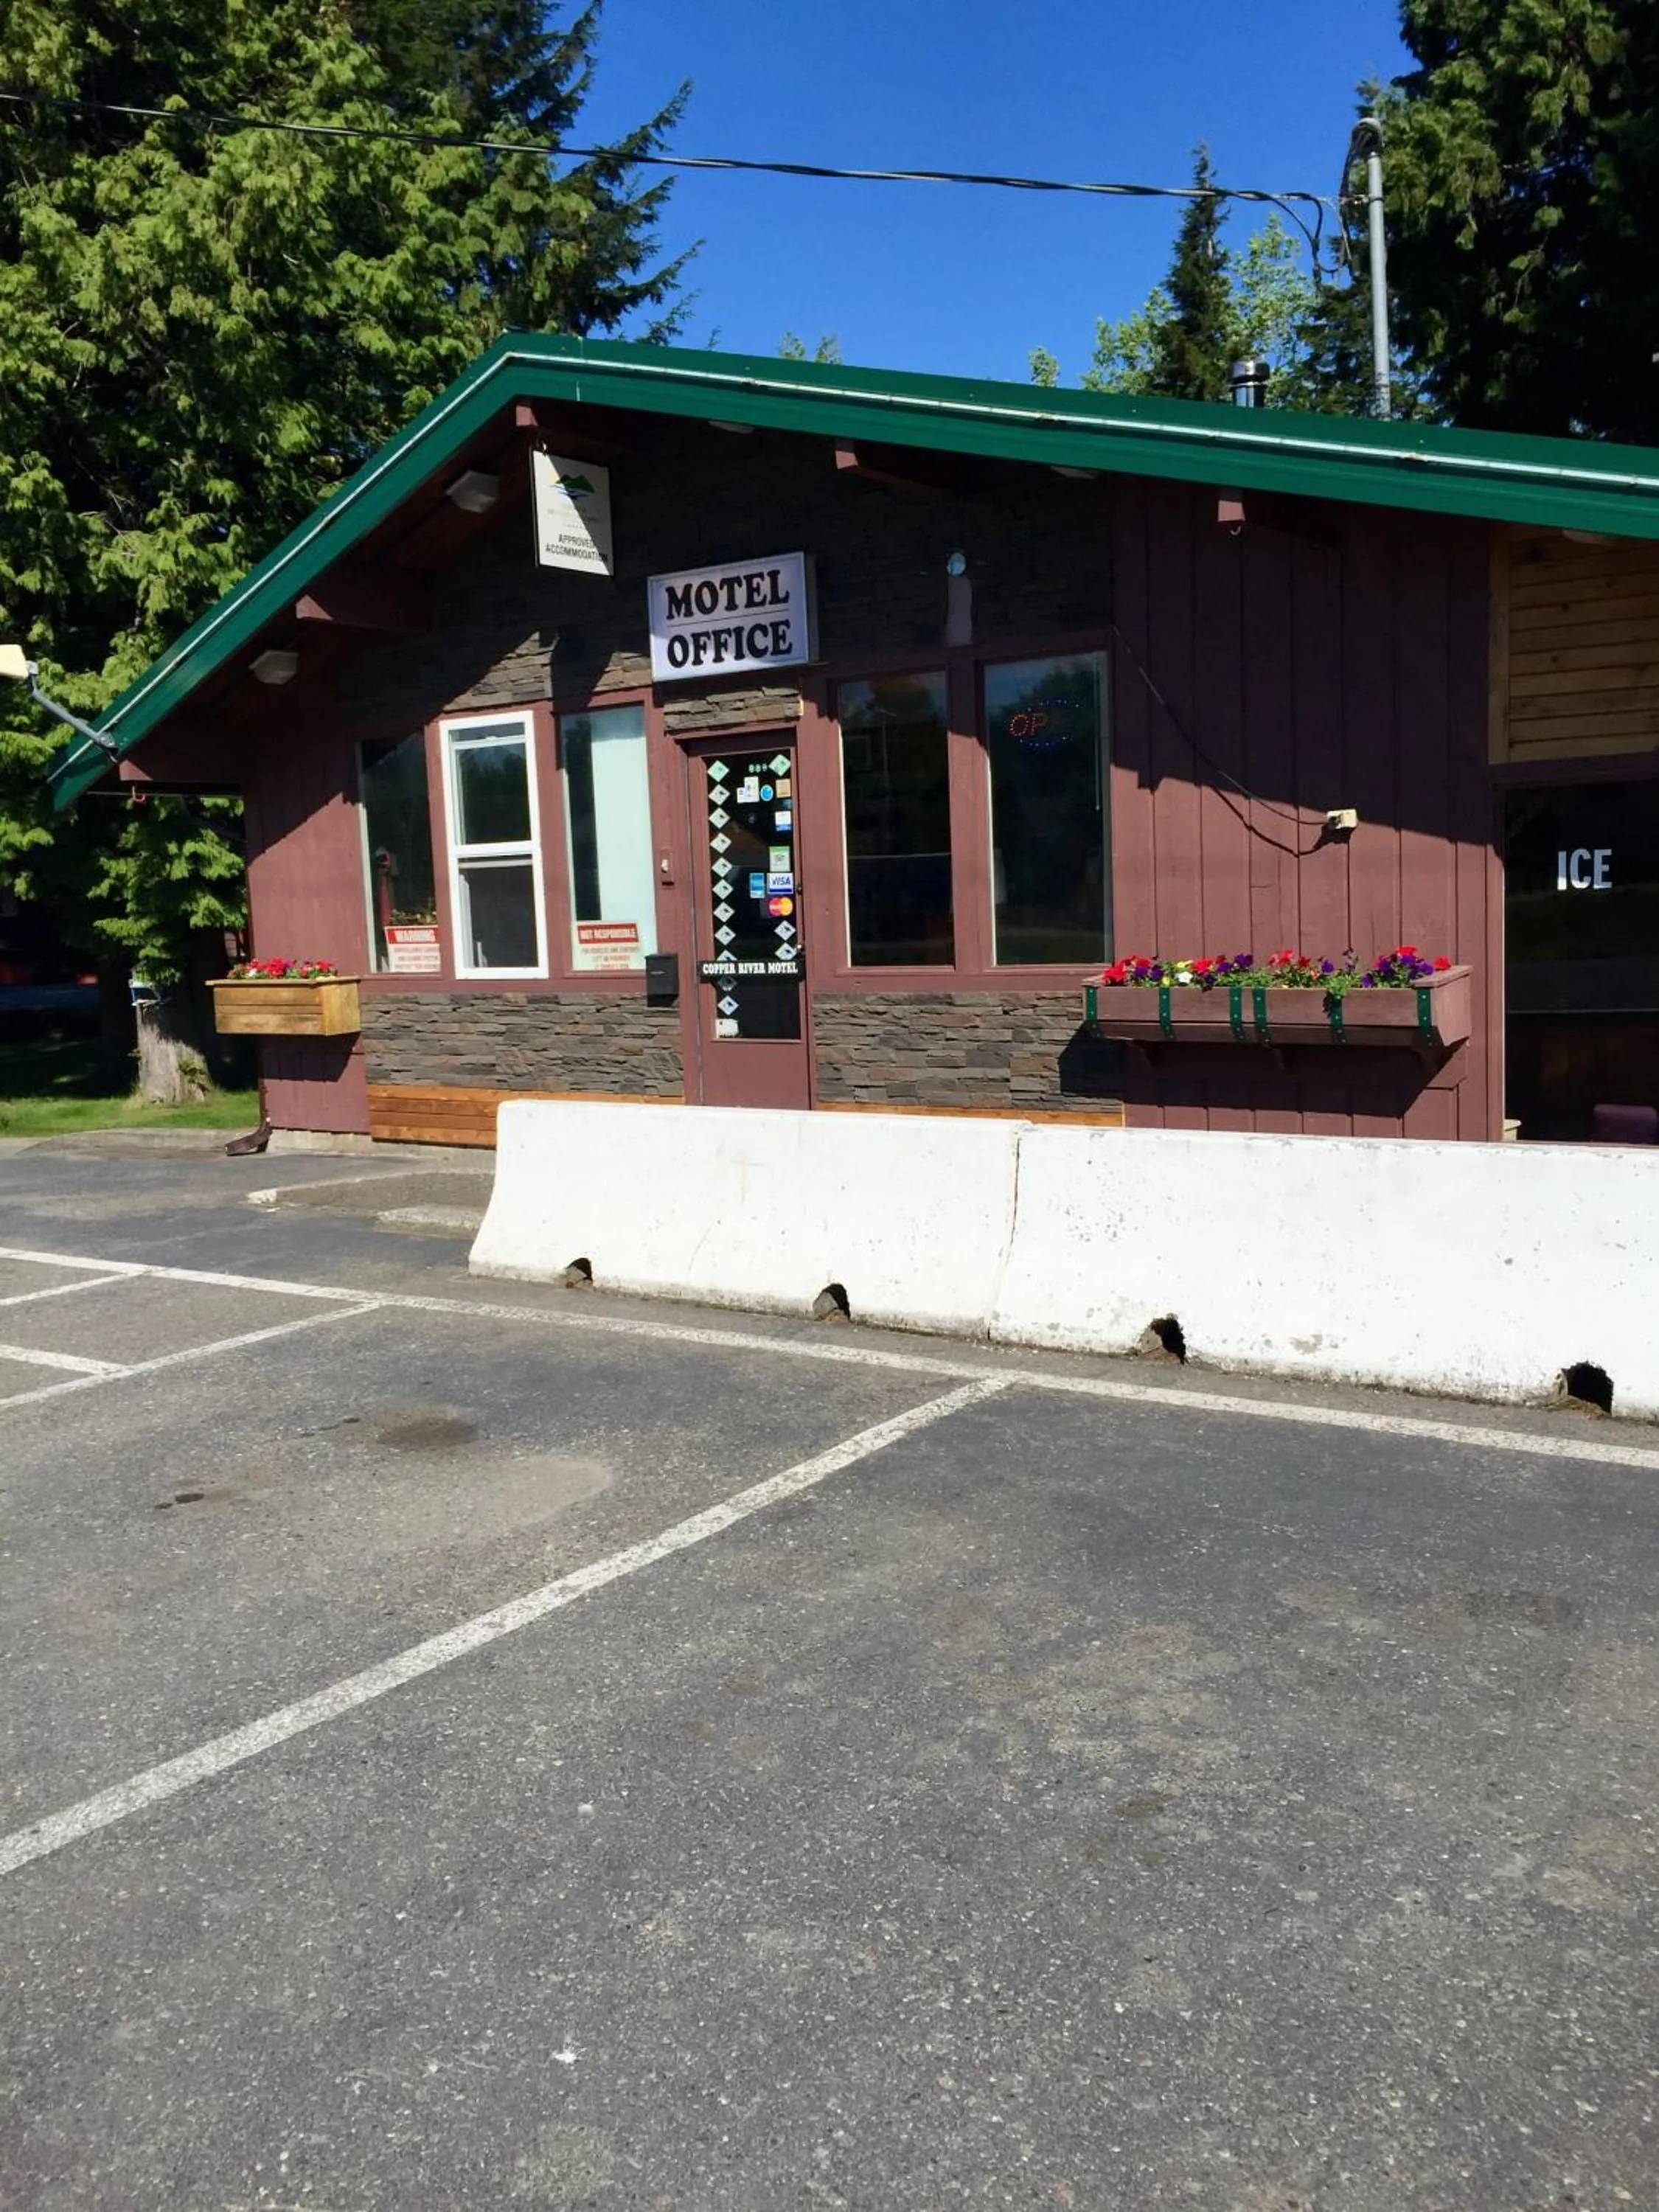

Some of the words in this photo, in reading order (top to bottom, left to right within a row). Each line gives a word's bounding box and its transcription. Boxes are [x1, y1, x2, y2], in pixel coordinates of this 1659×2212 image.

[558, 532, 595, 550] APPROVED
[665, 569, 790, 620] MOTEL
[667, 620, 792, 669] OFFICE
[772, 876, 791, 886] VISA
[1557, 848, 1613, 890] ICE
[703, 961, 736, 974] COPPER
[738, 961, 766, 974] RIVER
[768, 961, 799, 974] MOTEL
